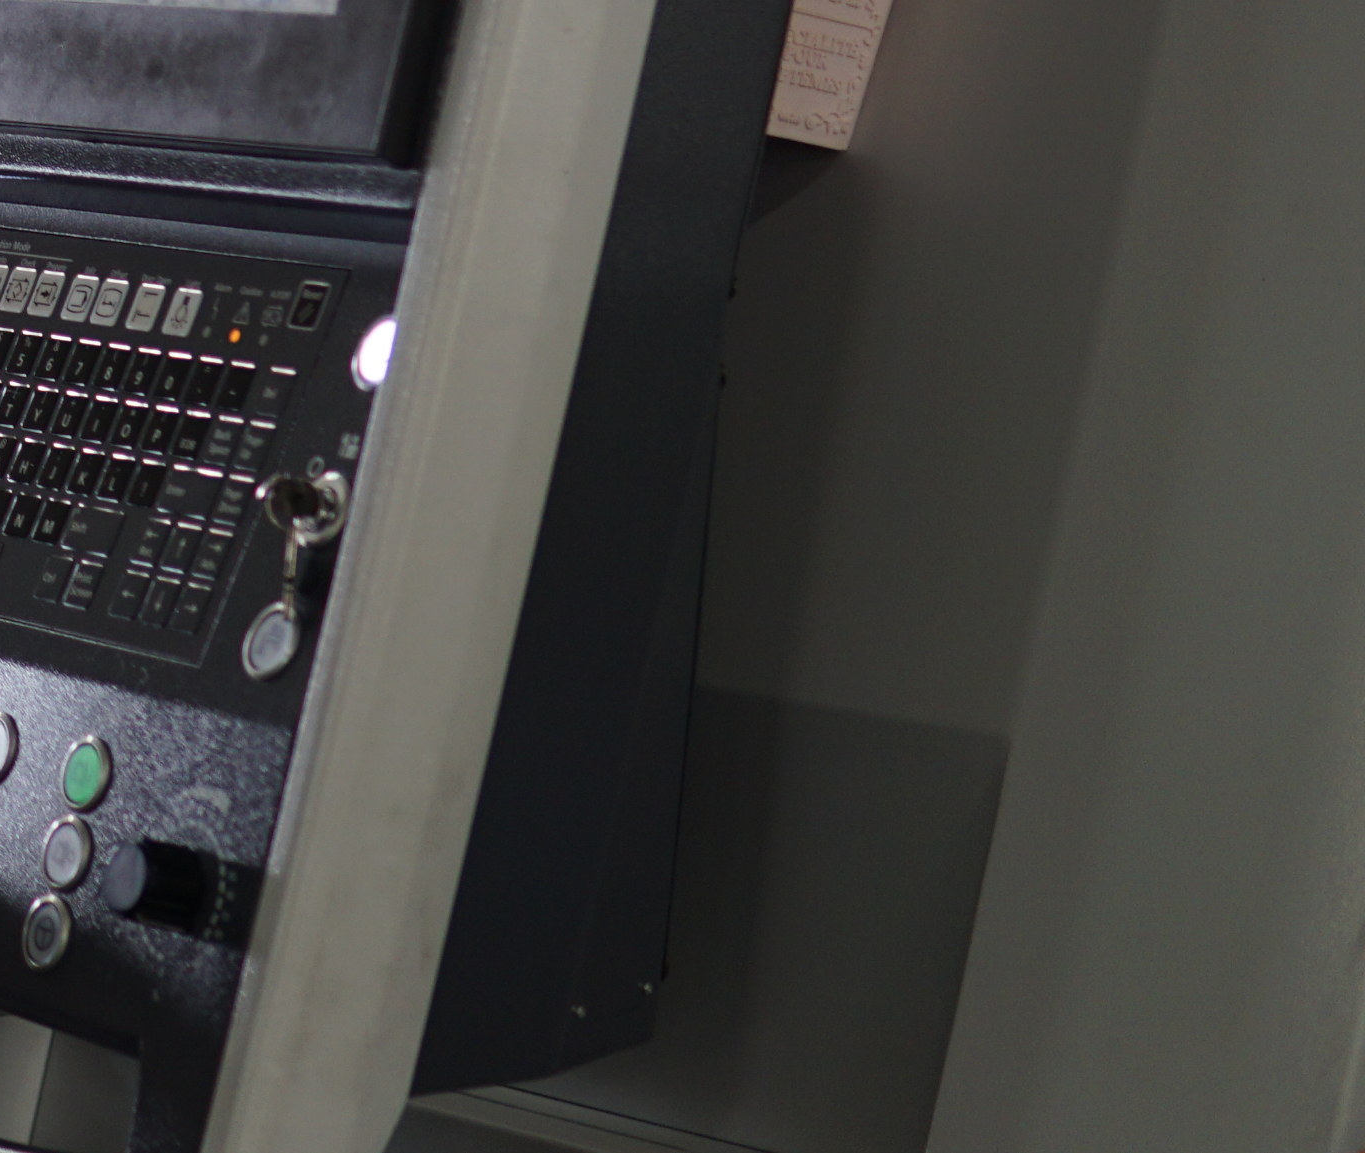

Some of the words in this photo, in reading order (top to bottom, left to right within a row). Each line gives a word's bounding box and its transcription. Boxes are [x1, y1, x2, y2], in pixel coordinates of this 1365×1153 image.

[12, 241, 31, 251] Mode
[16, 354, 26, 367] 5
[45, 358, 55, 372] 6
[74, 362, 84, 376] 7
[104, 366, 114, 381] 8
[134, 371, 144, 385] 9
[5, 404, 14, 418] T
[34, 408, 43, 422] Y
[62, 414, 72, 428] U
[151, 429, 162, 443] P
[19, 460, 30, 474] H
[48, 466, 57, 480] J
[78, 471, 89, 486] K
[107, 476, 116, 492] L
[14, 513, 25, 529] N
[42, 519, 56, 535] M
